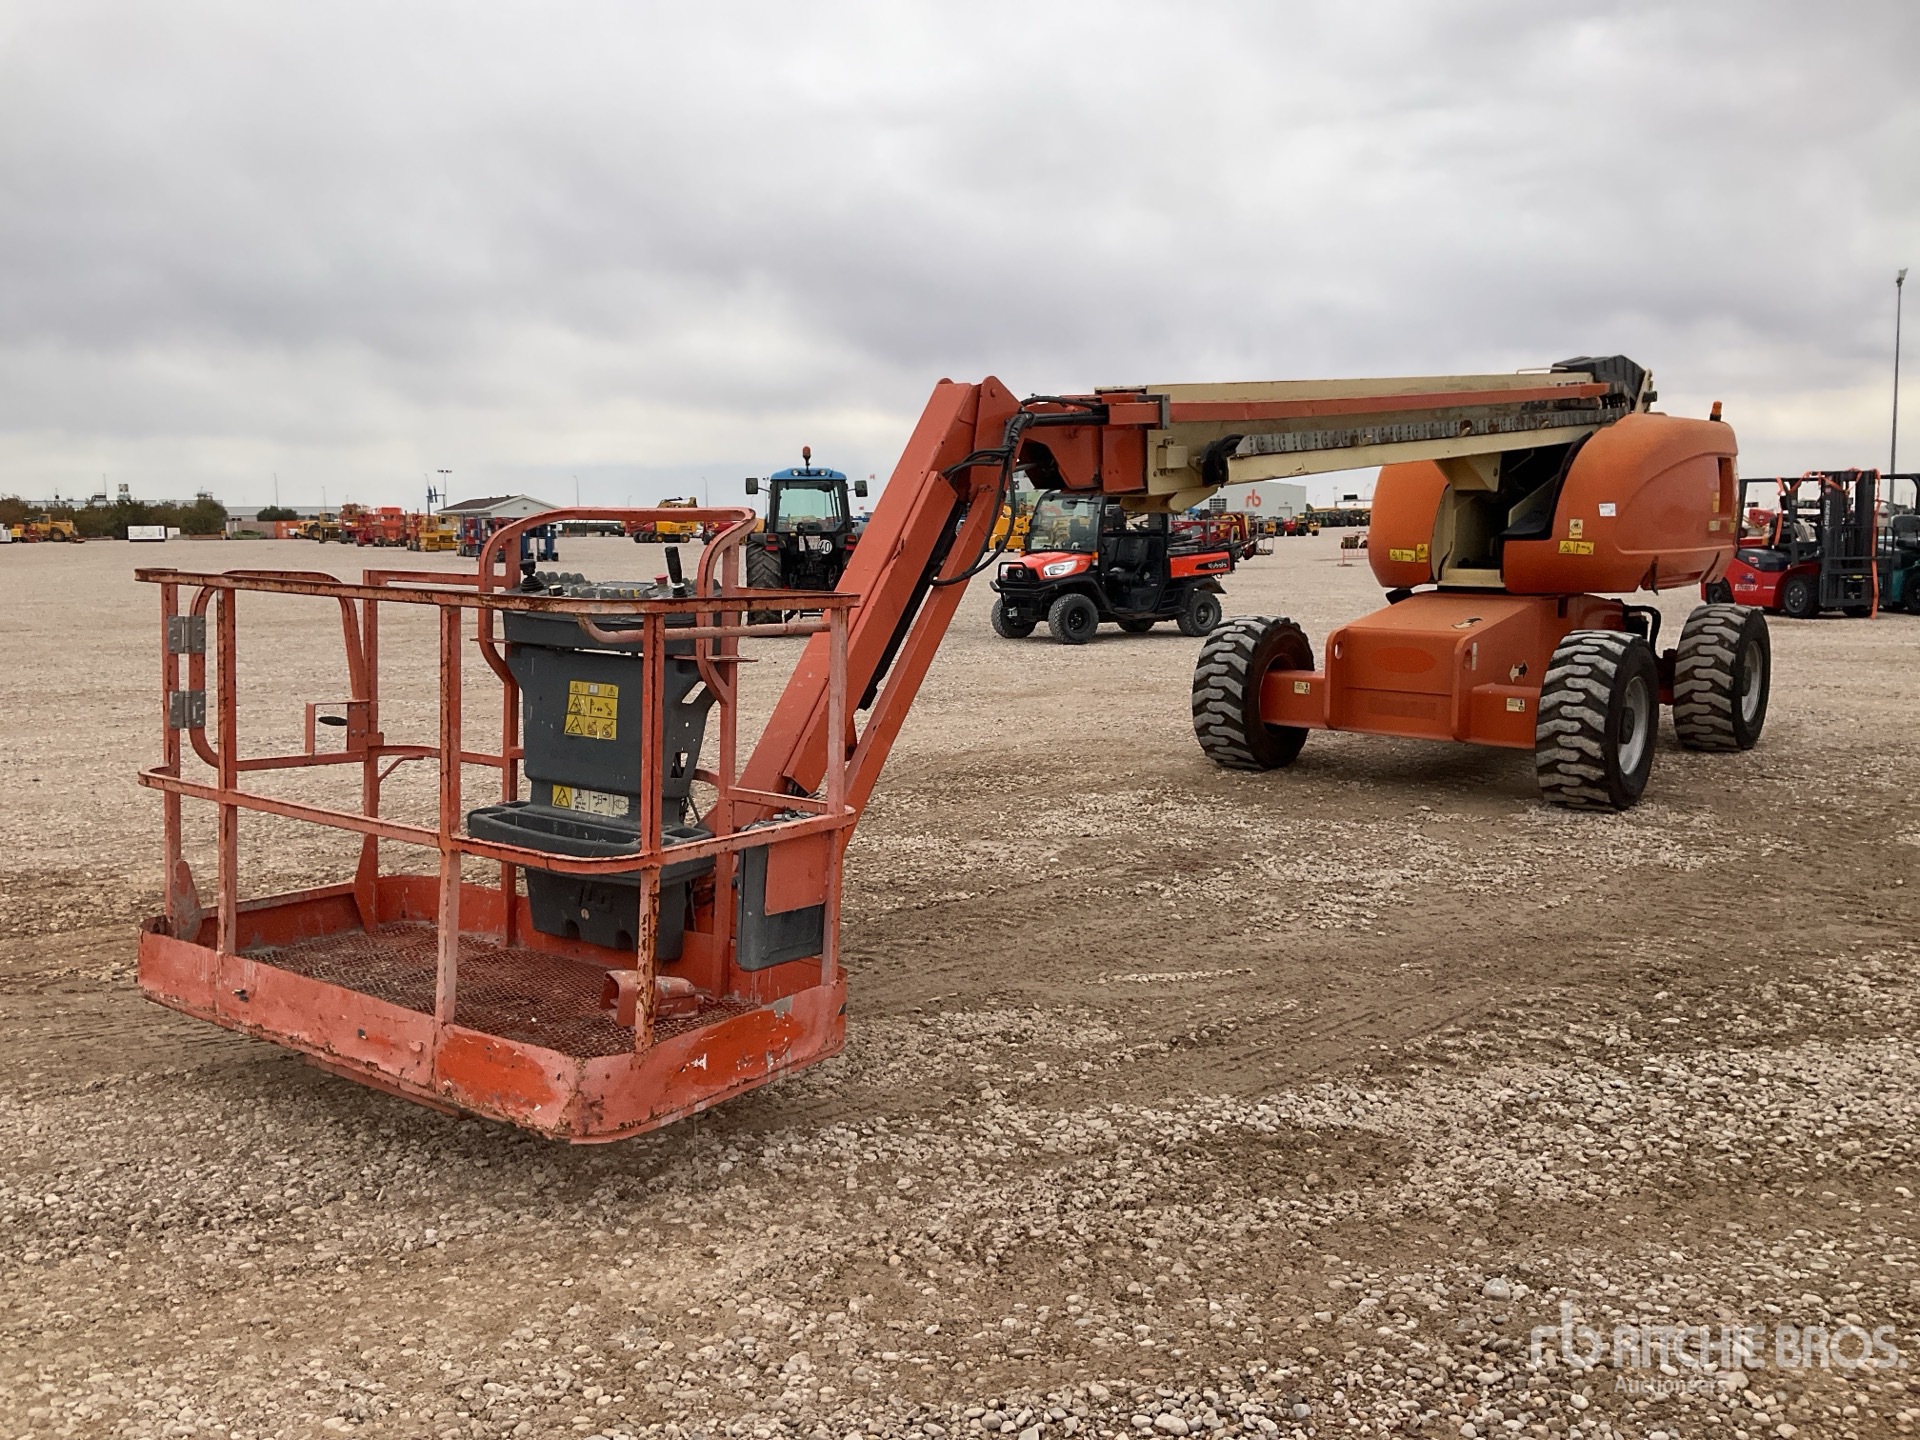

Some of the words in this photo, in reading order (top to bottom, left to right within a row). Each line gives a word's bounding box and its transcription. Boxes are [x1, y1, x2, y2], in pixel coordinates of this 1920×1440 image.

[1245, 488, 1262, 508] rb
[819, 541, 831, 552] 40
[1734, 583, 1759, 592] ENERGY
